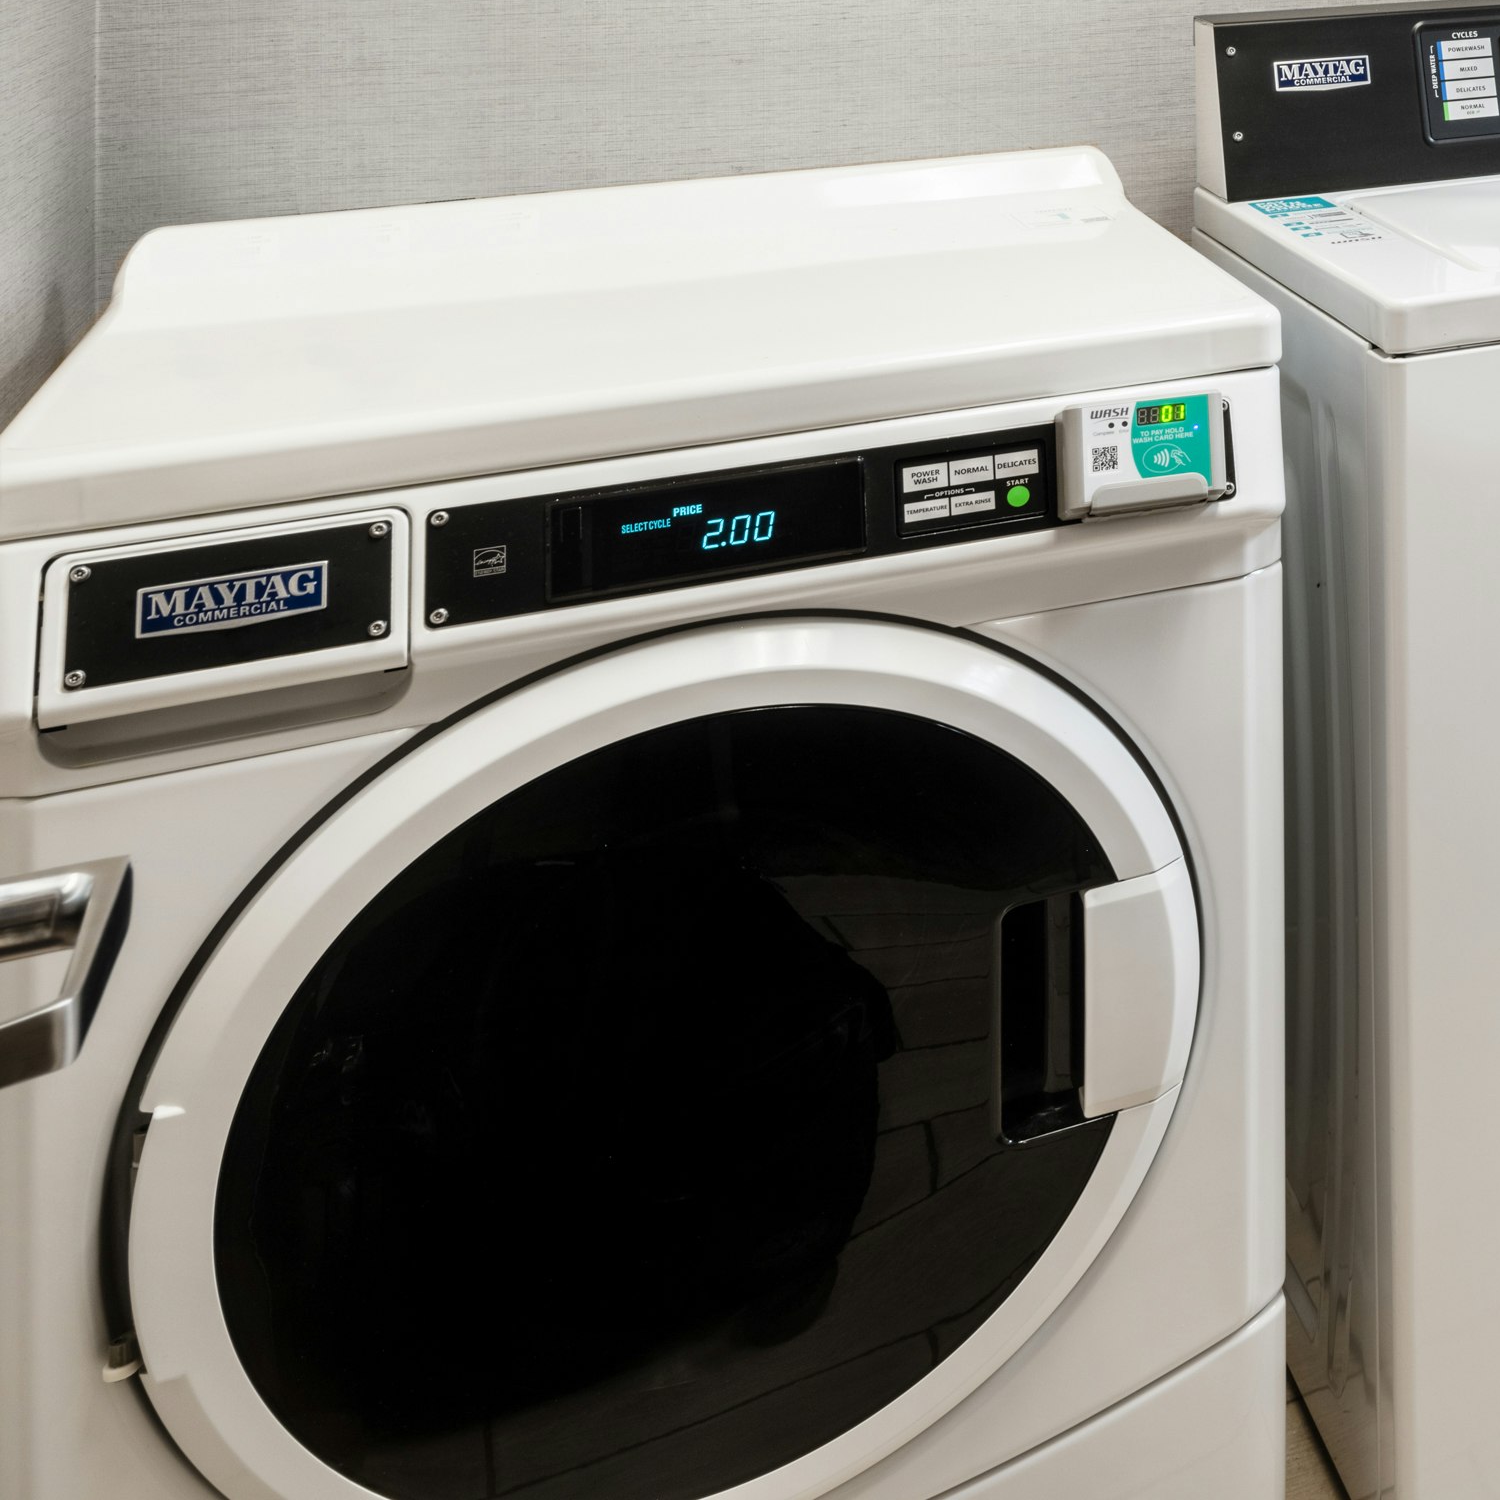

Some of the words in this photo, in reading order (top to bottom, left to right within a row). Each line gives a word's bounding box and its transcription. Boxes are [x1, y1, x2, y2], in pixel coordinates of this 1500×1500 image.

[1451, 31, 1478, 39] CYCLES
[1279, 59, 1364, 81] MAYTAG
[1294, 76, 1351, 86] COMMERCIAL
[1090, 407, 1129, 420] WASH
[1161, 404, 1185, 422] 01
[1151, 428, 1164, 436] PAY
[1154, 434, 1174, 442] CARD
[1174, 431, 1193, 439] HERE
[997, 458, 1036, 470] DELICATES
[911, 469, 940, 479] POWER
[954, 465, 989, 476] NORMAL
[913, 476, 938, 485] WASH
[1006, 478, 1029, 487] START
[935, 488, 965, 497] OPTIONS
[906, 504, 947, 515] TEMPERATURE
[955, 500, 973, 508] EXTRA
[672, 504, 703, 518] PRICE
[621, 522, 648, 535] SELECT
[649, 518, 671, 531] CYCLE
[702, 510, 775, 550] 2.00
[146, 569, 318, 620] MAYTAG
[173, 599, 289, 627] COMMERCIAL
